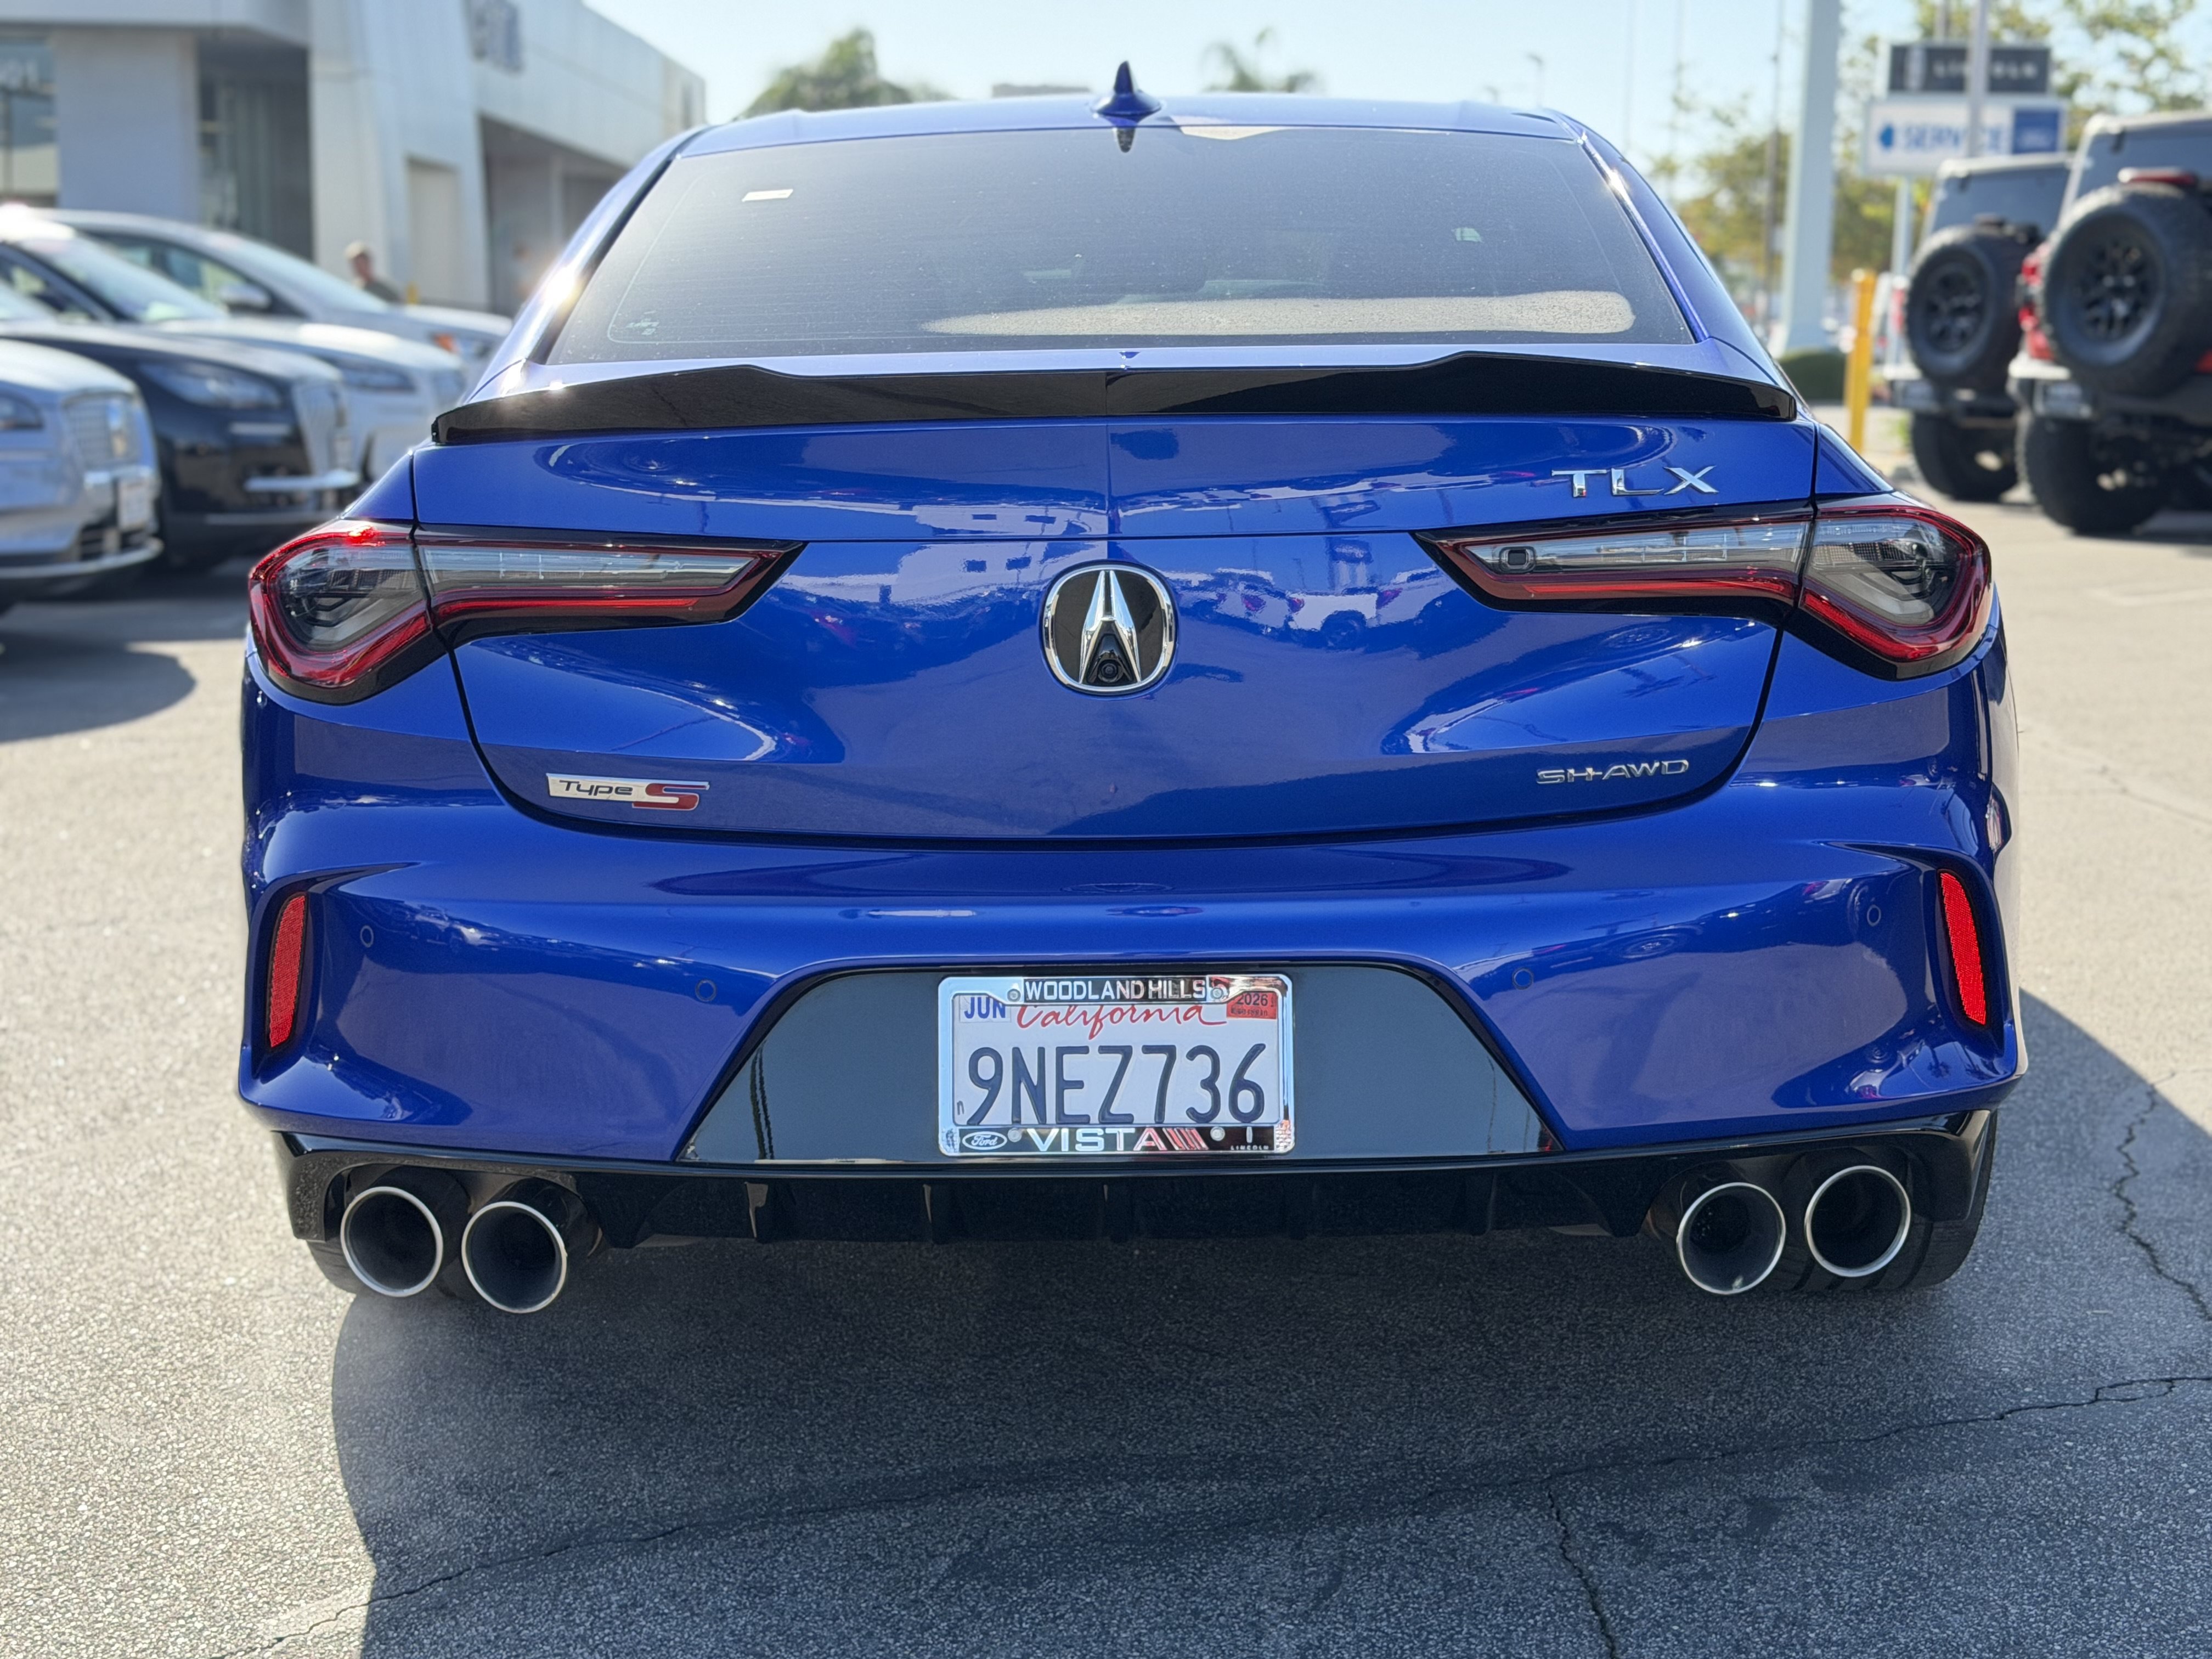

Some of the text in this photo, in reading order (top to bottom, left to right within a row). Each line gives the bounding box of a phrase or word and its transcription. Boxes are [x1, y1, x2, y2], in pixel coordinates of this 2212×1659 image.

[1551, 465, 1719, 497] TLX
[1537, 759, 1689, 785] SH-AWD
[559, 780, 709, 811] Type S
[1025, 979, 1206, 1001] WOODLAND HILLS
[1237, 992, 1268, 1007] 2026
[964, 997, 1006, 1019] JUN
[1016, 1004, 1227, 1040] California
[967, 1043, 1266, 1125] 9NEZ736
[970, 1134, 998, 1146] Ford
[1026, 1127, 1166, 1152] VISTA
